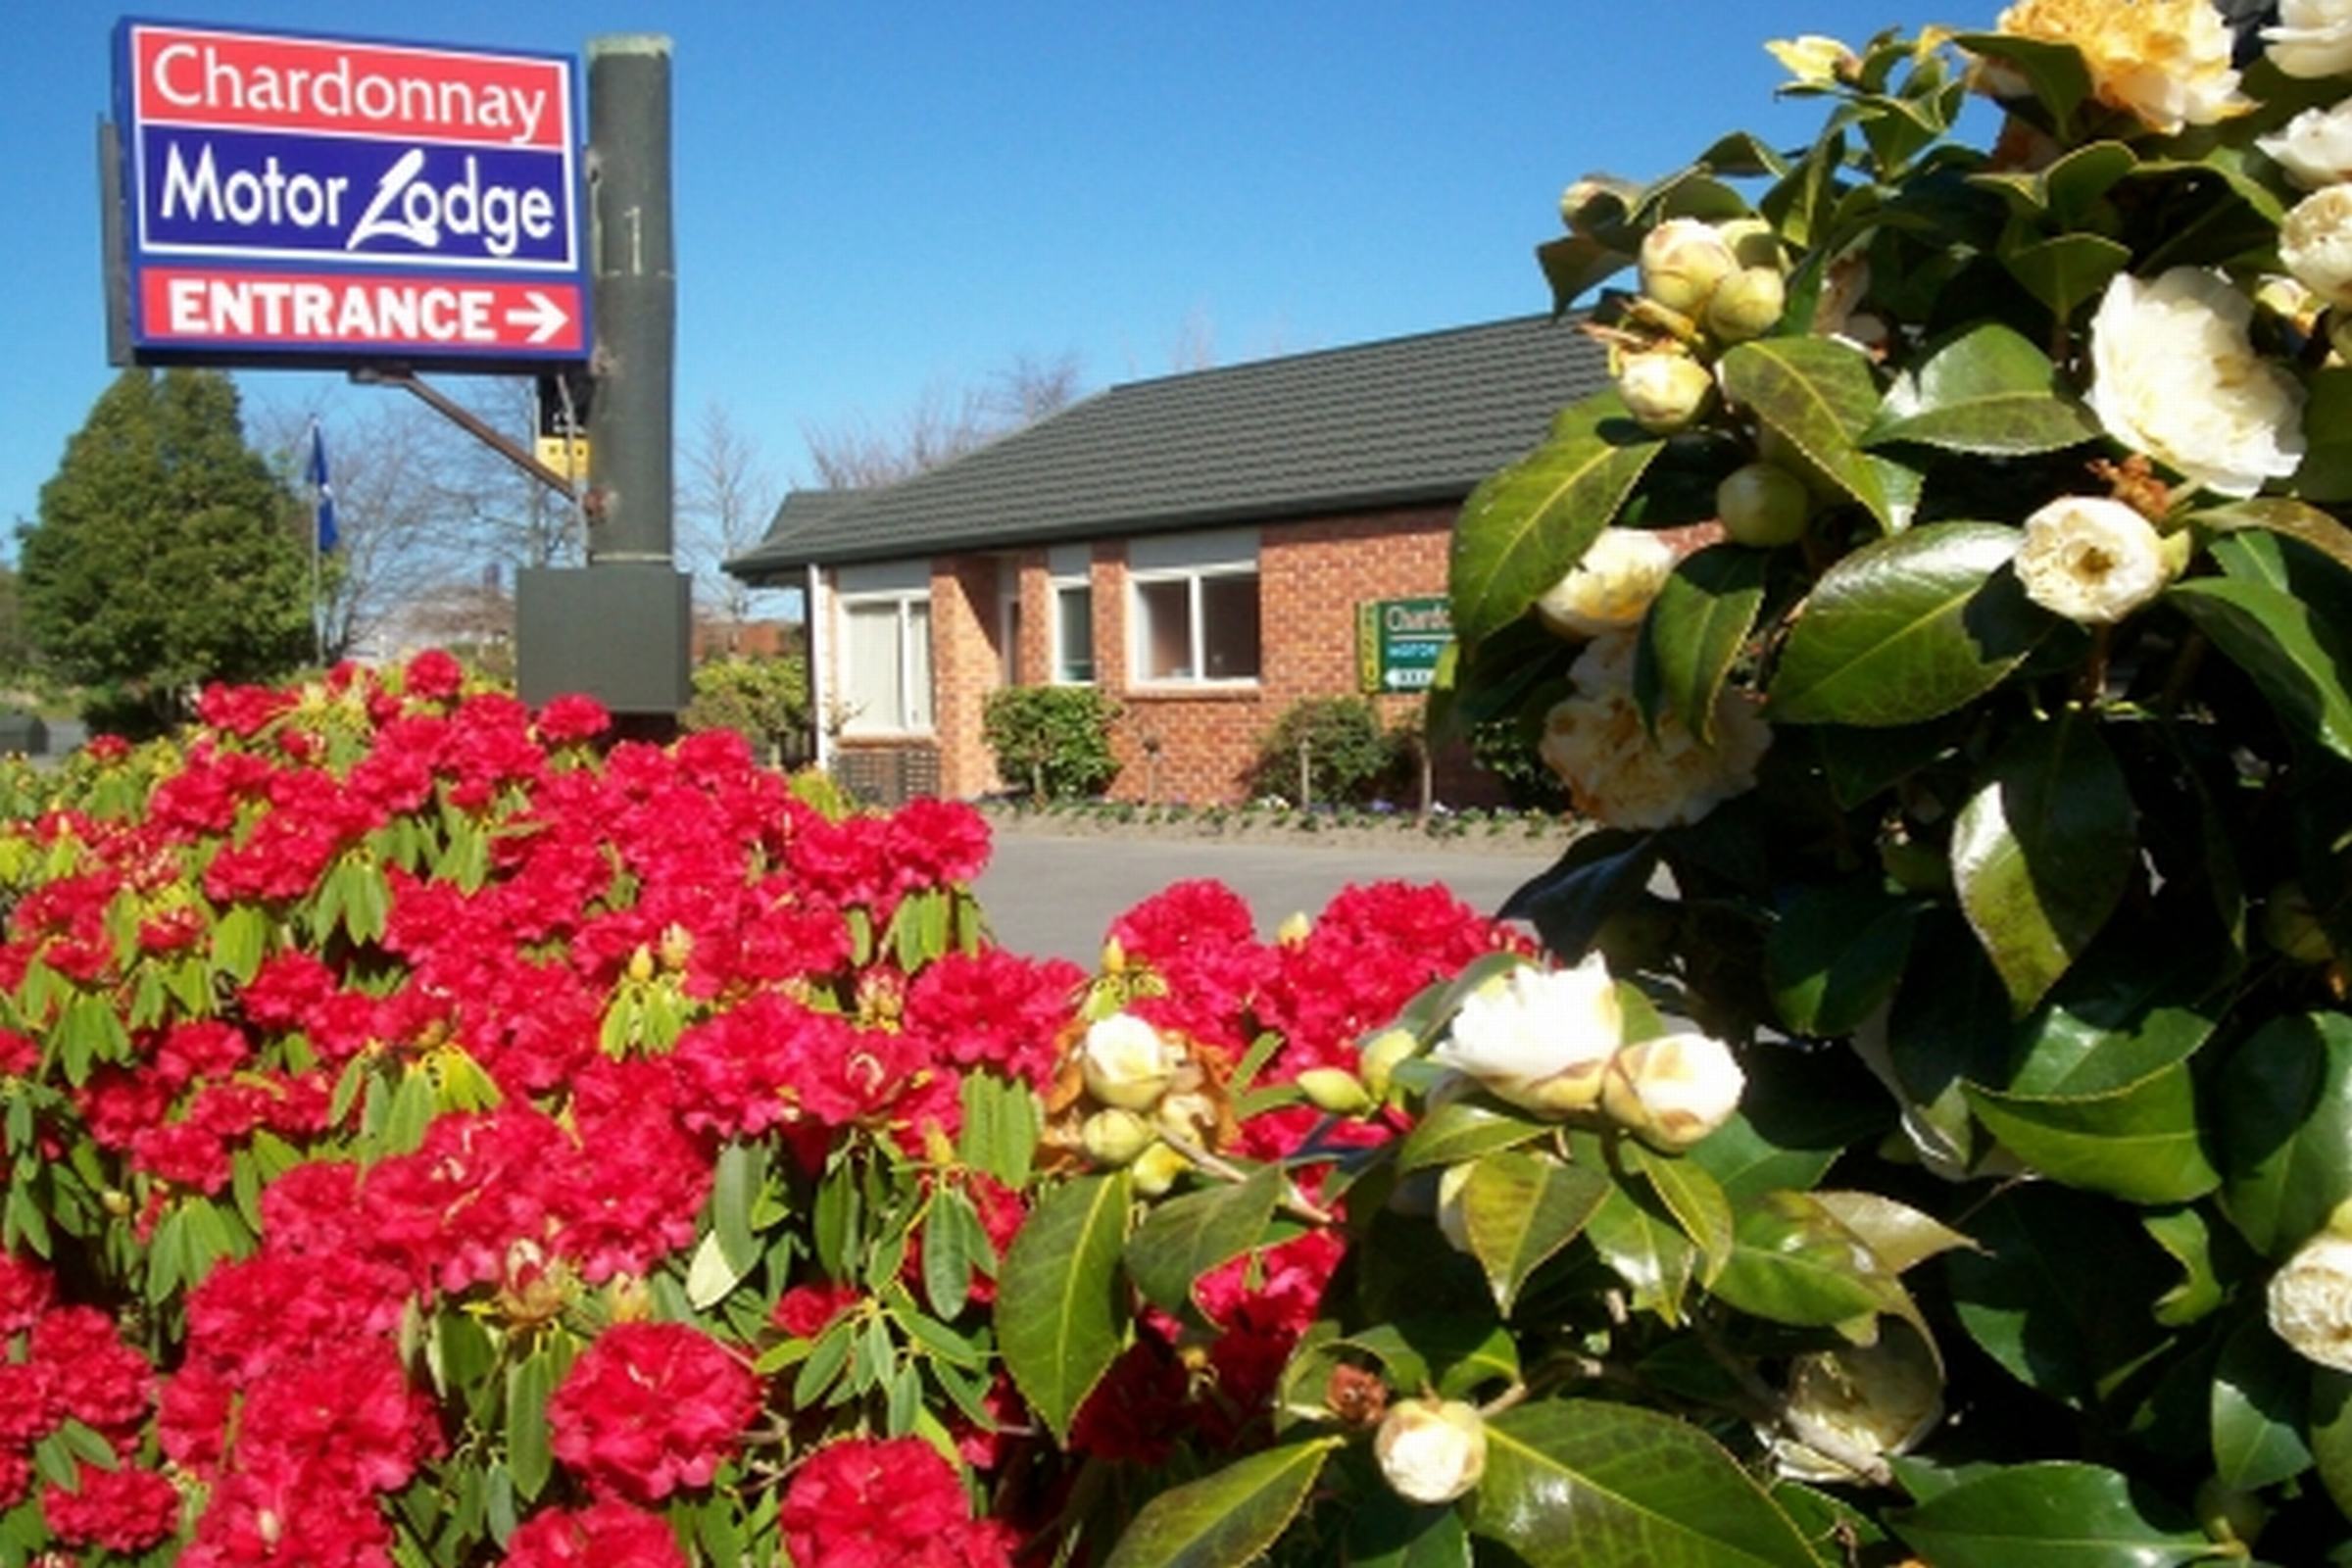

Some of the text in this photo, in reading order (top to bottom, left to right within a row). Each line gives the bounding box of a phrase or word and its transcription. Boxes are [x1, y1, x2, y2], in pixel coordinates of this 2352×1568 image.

[153, 43, 546, 144] Chardonnay
[160, 141, 556, 256] Motor Lodge
[168, 278, 498, 342] ENTRANCE
